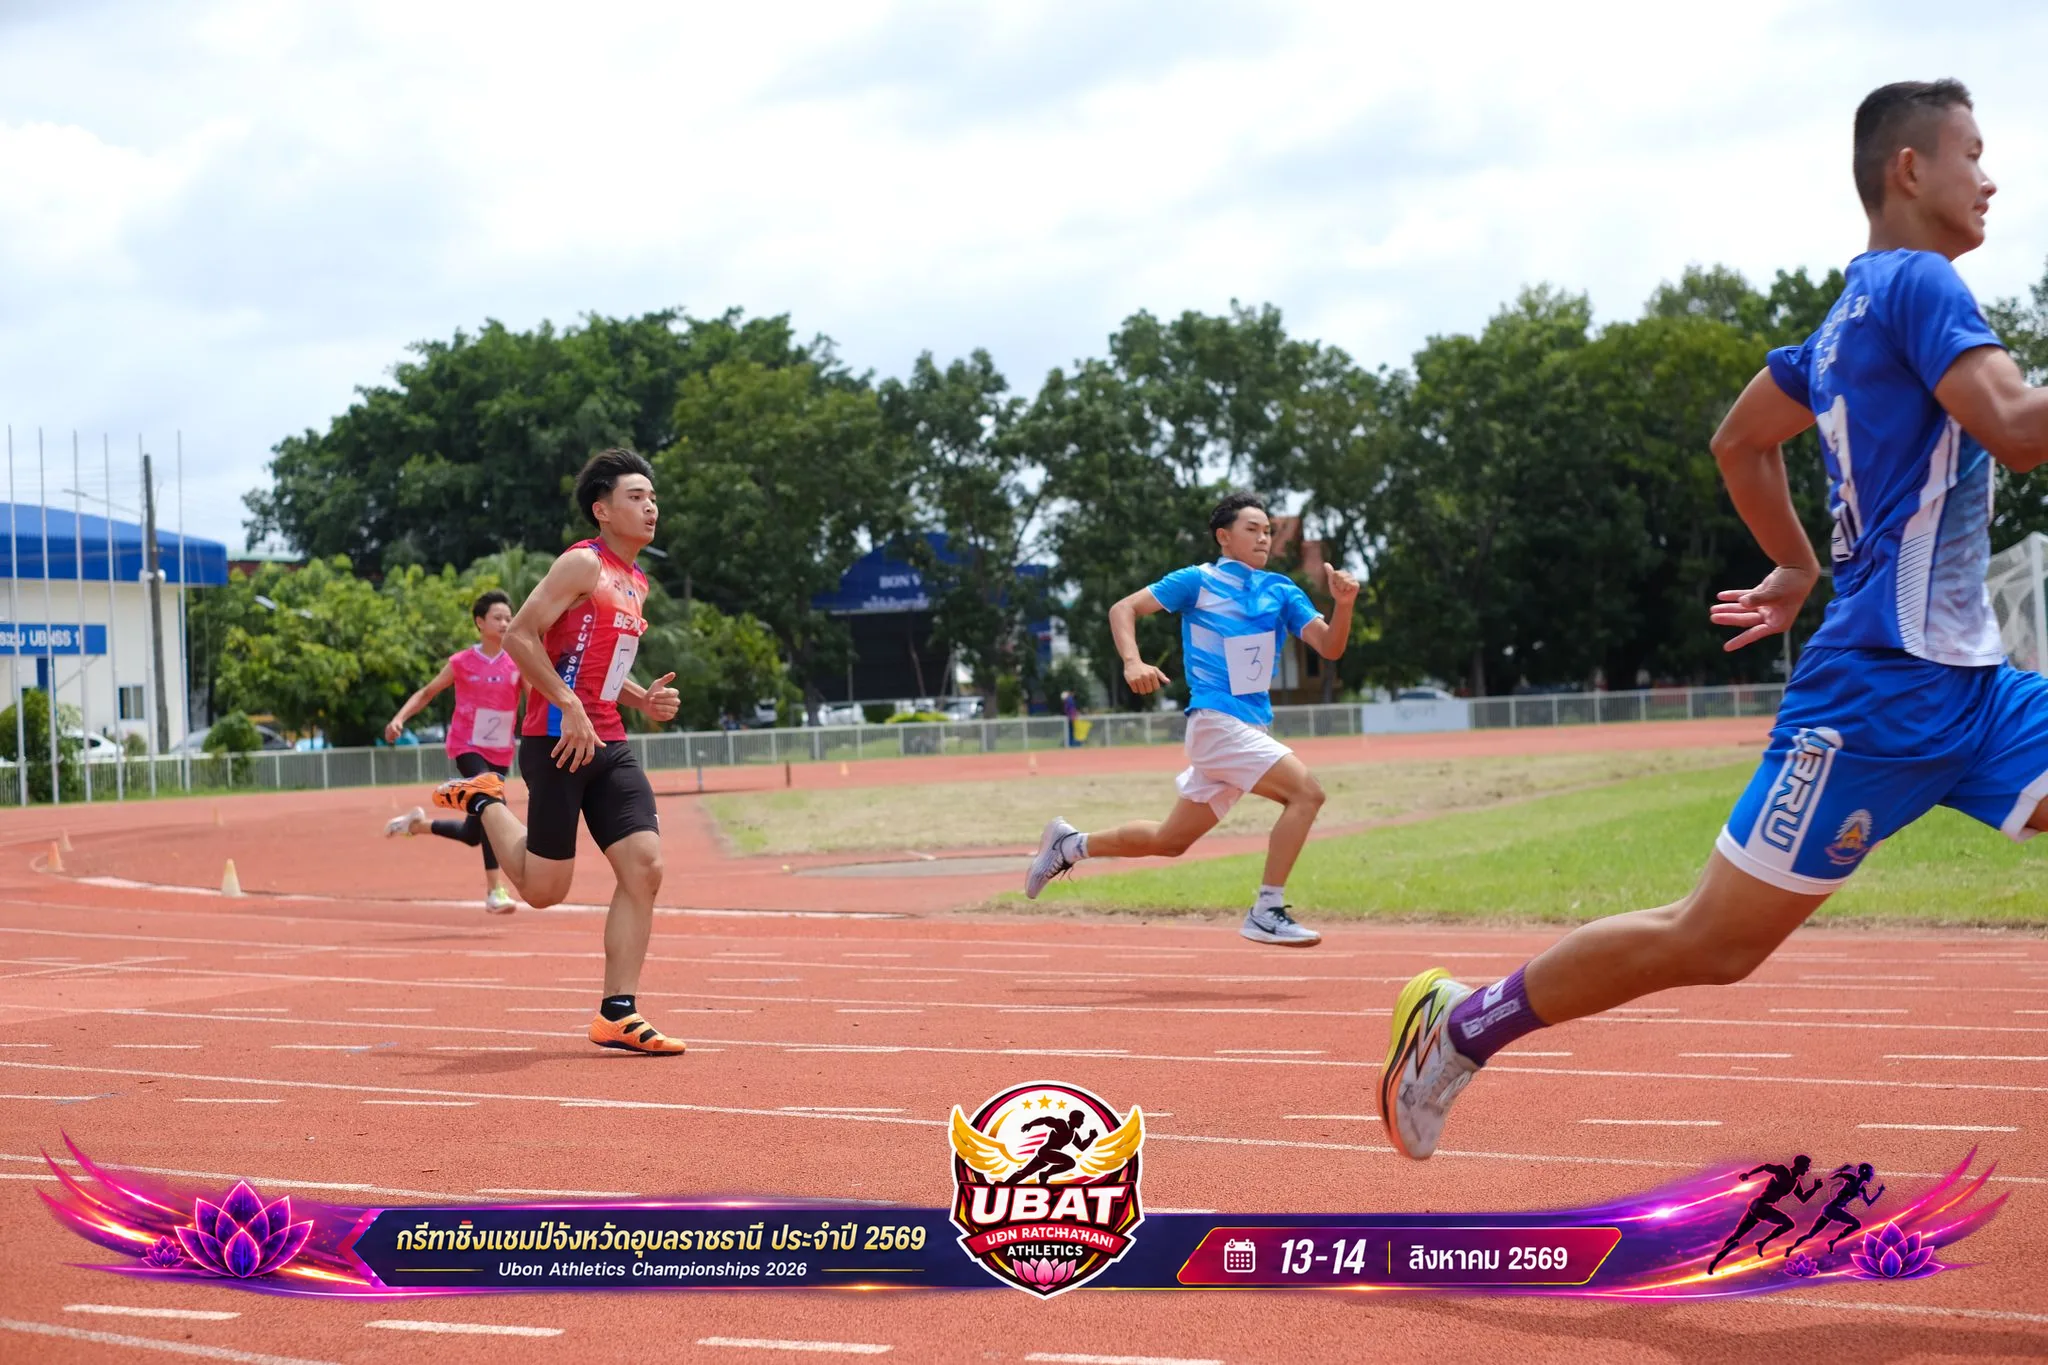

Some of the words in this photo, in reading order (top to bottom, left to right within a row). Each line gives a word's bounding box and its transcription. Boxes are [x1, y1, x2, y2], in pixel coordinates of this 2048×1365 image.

[575, 614, 593, 652] CLUB
[612, 648, 630, 691] 5
[1244, 646, 1263, 681] 3
[483, 716, 501, 741] 2
